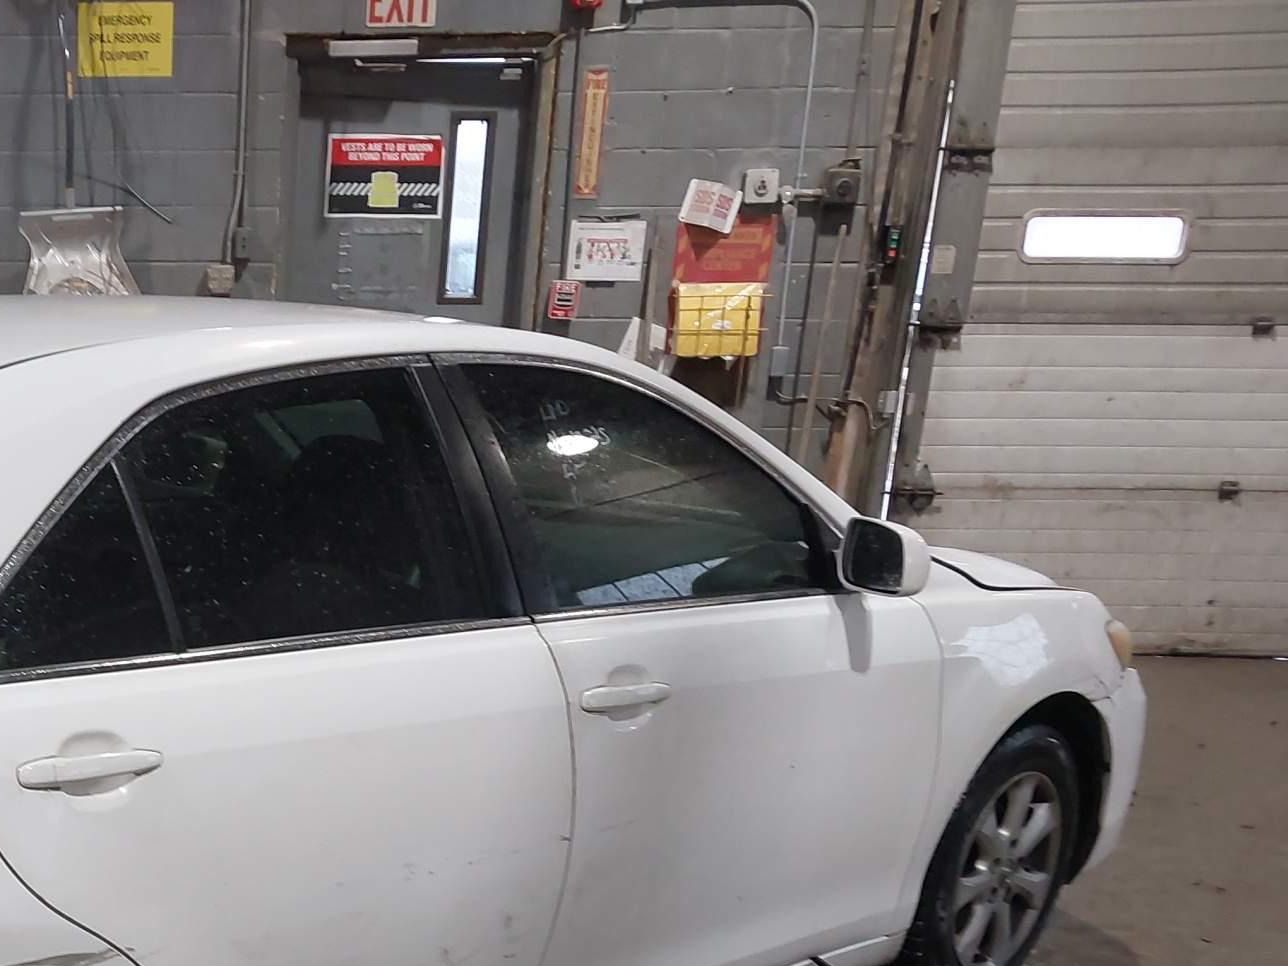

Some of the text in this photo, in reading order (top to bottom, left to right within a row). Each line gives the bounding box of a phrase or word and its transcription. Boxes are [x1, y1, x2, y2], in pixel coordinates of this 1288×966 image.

[98, 15, 152, 26] EMERGENCY
[114, 32, 161, 44] RESPONSE
[99, 50, 150, 62] EQUIPMENT
[340, 142, 434, 153] VESTS ARE TO BE WORN
[347, 152, 426, 161] BEYOND THIS POINT
